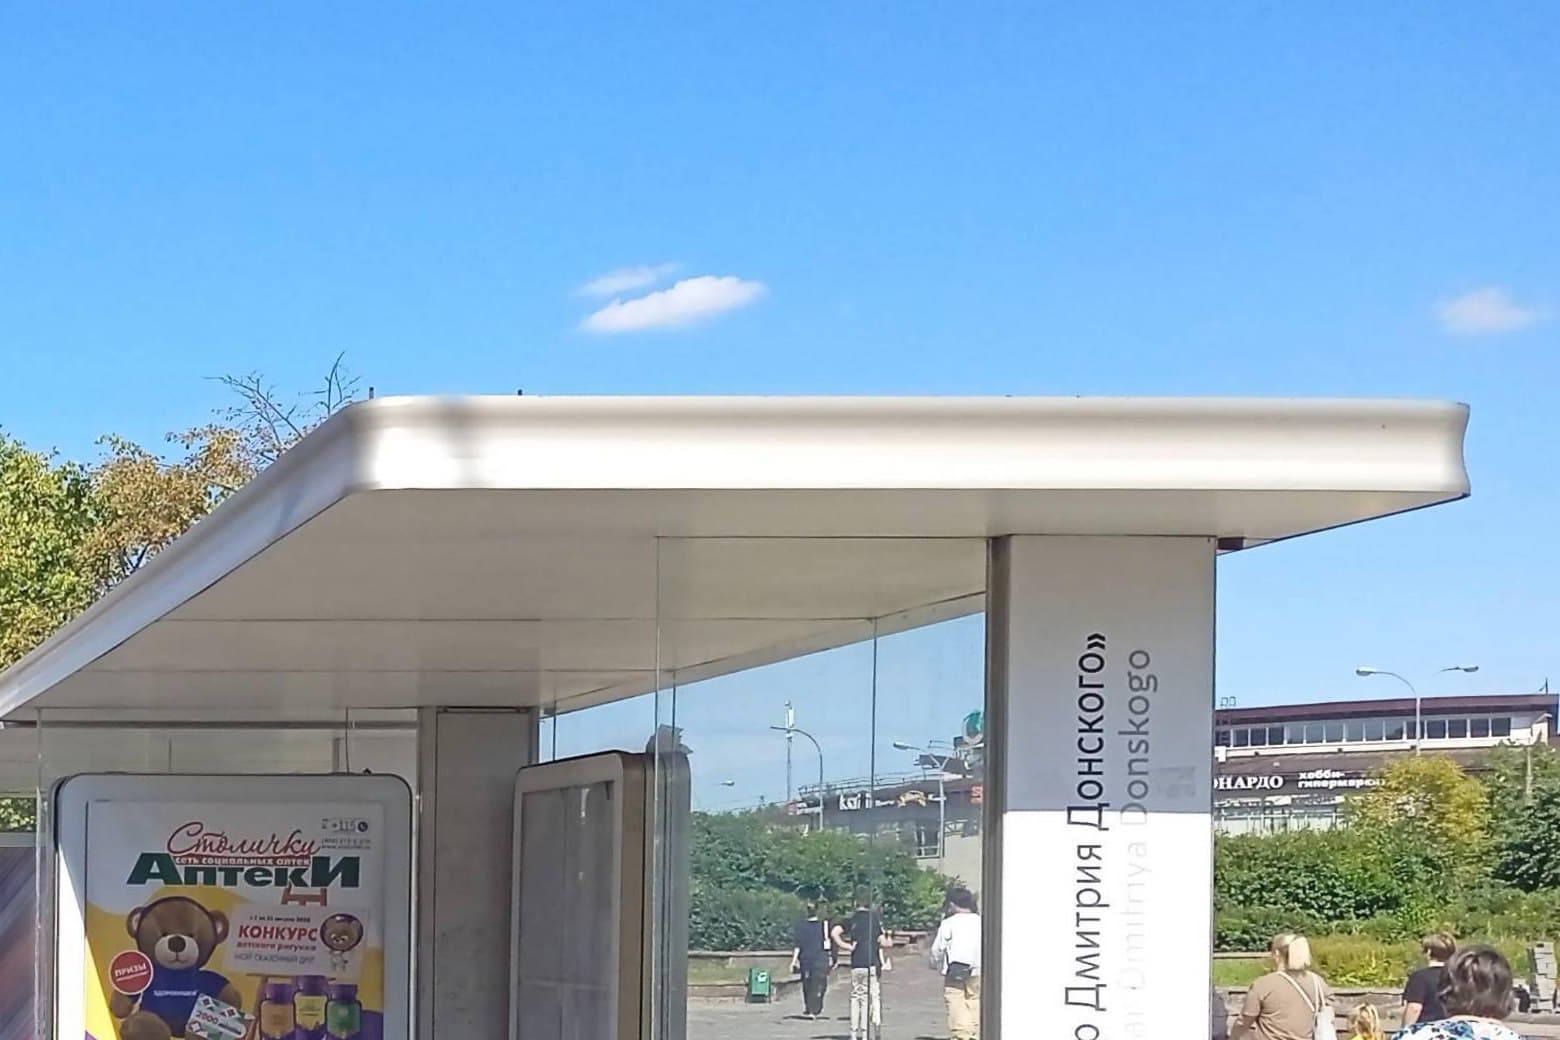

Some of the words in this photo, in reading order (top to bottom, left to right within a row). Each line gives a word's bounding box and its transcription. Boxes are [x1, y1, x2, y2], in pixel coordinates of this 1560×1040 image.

[1066, 633, 1110, 832] Донского»
[1118, 649, 1158, 824] Donskogo
[167, 821, 321, 856] Столички
[175, 856, 199, 865] сеть
[202, 856, 273, 867] социальных
[276, 857, 310, 866] аптек
[239, 925, 318, 941] КОНКУРС
[1064, 844, 1110, 1012] Дмитрия
[1117, 840, 1153, 991] Dmitriya
[114, 962, 147, 978] ПРИЗЫ
